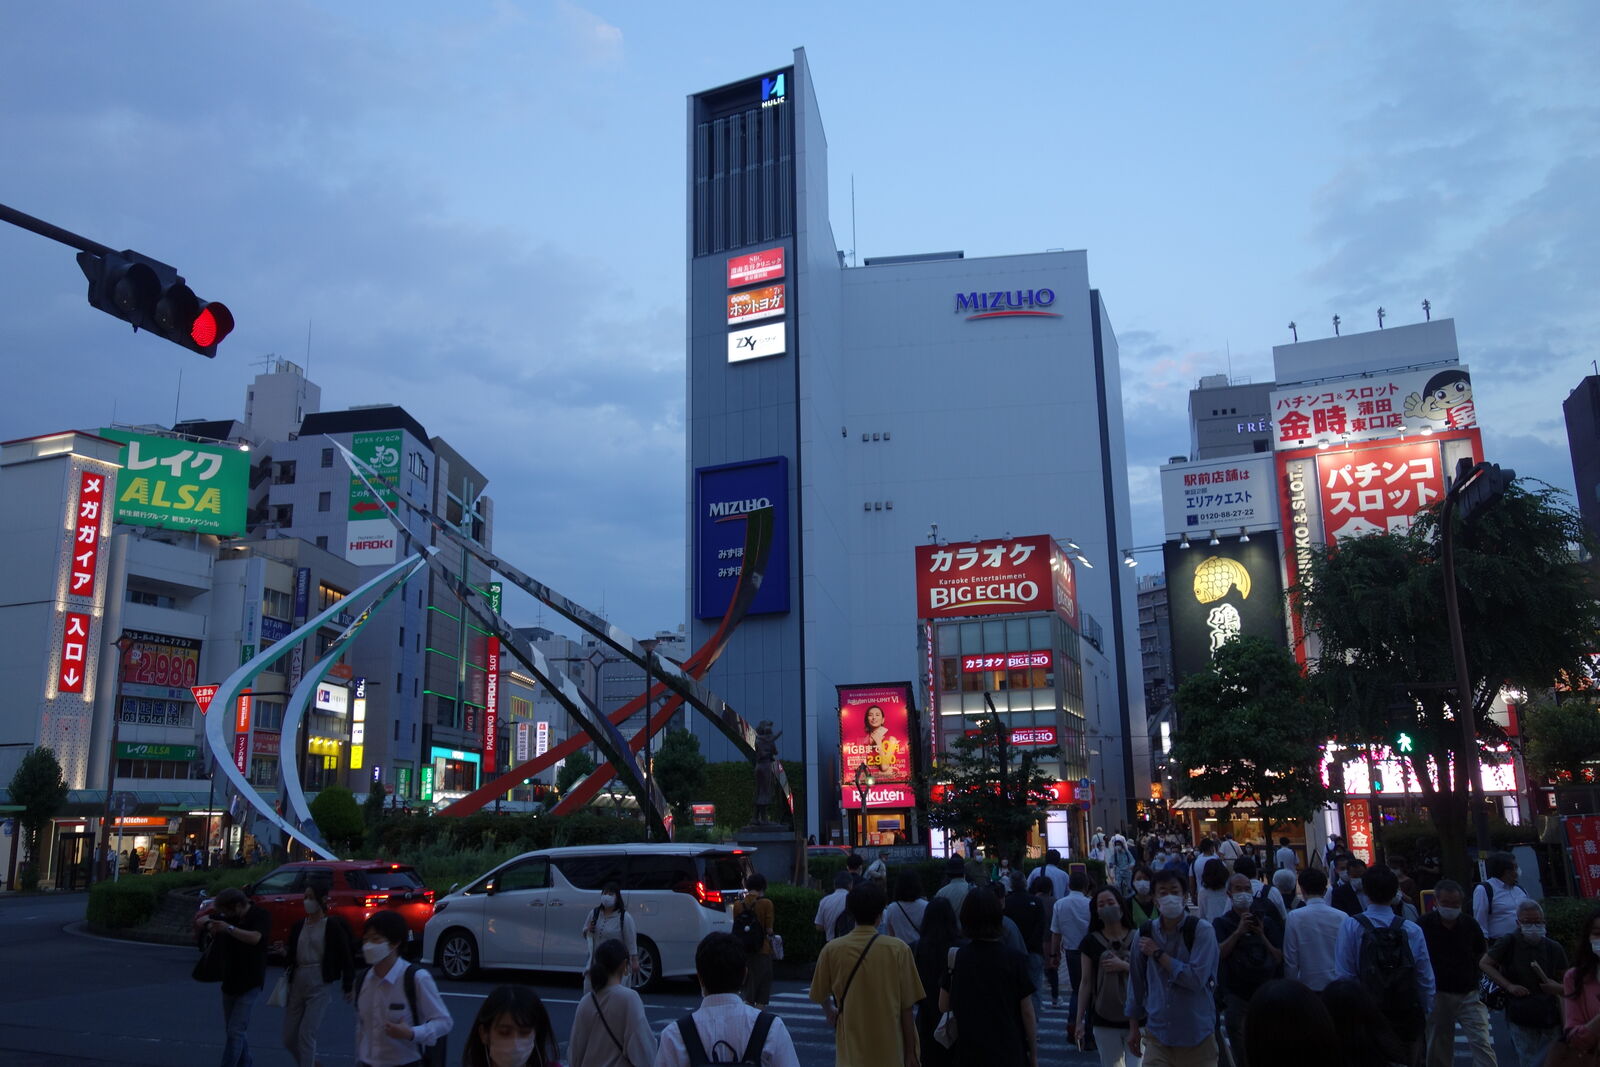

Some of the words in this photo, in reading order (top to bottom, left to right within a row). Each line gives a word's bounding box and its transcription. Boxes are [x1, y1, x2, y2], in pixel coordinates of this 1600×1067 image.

[762, 97, 785, 108] HULIC
[730, 294, 783, 317] ホットヨガ
[955, 288, 1055, 313] MIZUHO
[1358, 399, 1393, 417] 蒲田
[1278, 405, 1348, 442] 金時
[1351, 413, 1403, 432] 東口店
[127, 441, 223, 481] レイク
[1184, 468, 1250, 486] 駅前店舗は
[1325, 457, 1435, 489] パチンコ
[120, 477, 221, 514] ALSA
[1186, 490, 1253, 509] エリアクエスト
[1330, 482, 1438, 515] スロット
[709, 497, 772, 517] MIZUHO
[72, 477, 101, 590] メガガイア
[350, 539, 393, 551] HIROKI
[929, 543, 1036, 573] カラオケ
[939, 576, 969, 585] Karaoke
[971, 573, 1026, 583] Entertainment
[930, 586, 972, 609] BIG
[975, 580, 1039, 602] ECHO
[65, 617, 86, 661] 入口
[489, 654, 497, 671] SLOT
[965, 657, 1004, 668] カラオケ
[1008, 657, 1025, 667] BIG
[196, 688, 214, 696] 止まれ
[487, 673, 497, 713] HIROKI
[486, 715, 495, 750] PACHINKO
[1012, 732, 1029, 743] BIG
